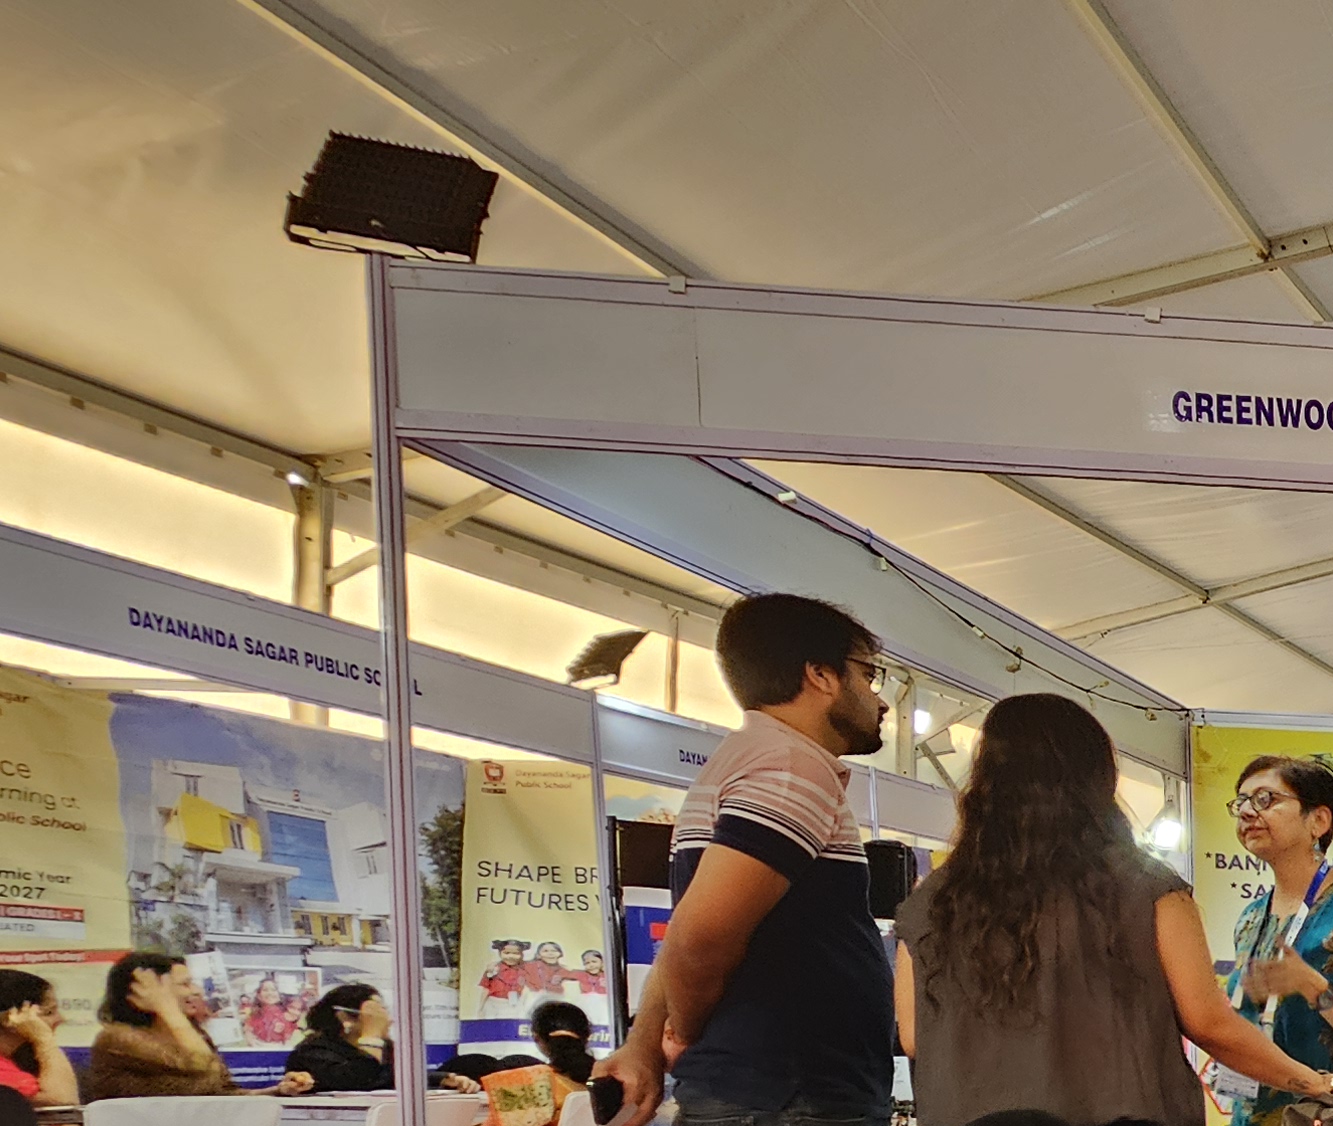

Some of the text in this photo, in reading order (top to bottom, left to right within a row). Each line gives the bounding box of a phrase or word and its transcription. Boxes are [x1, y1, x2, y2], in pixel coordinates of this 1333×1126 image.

[128, 606, 423, 696] DAYANANDA SAGAR PUBLIC SCL
[0, 787, 56, 811] rning
[30, 815, 87, 832] School
[35, 870, 72, 885] Year
[477, 860, 561, 884] SHAPE
[476, 887, 589, 911] FUTURES
